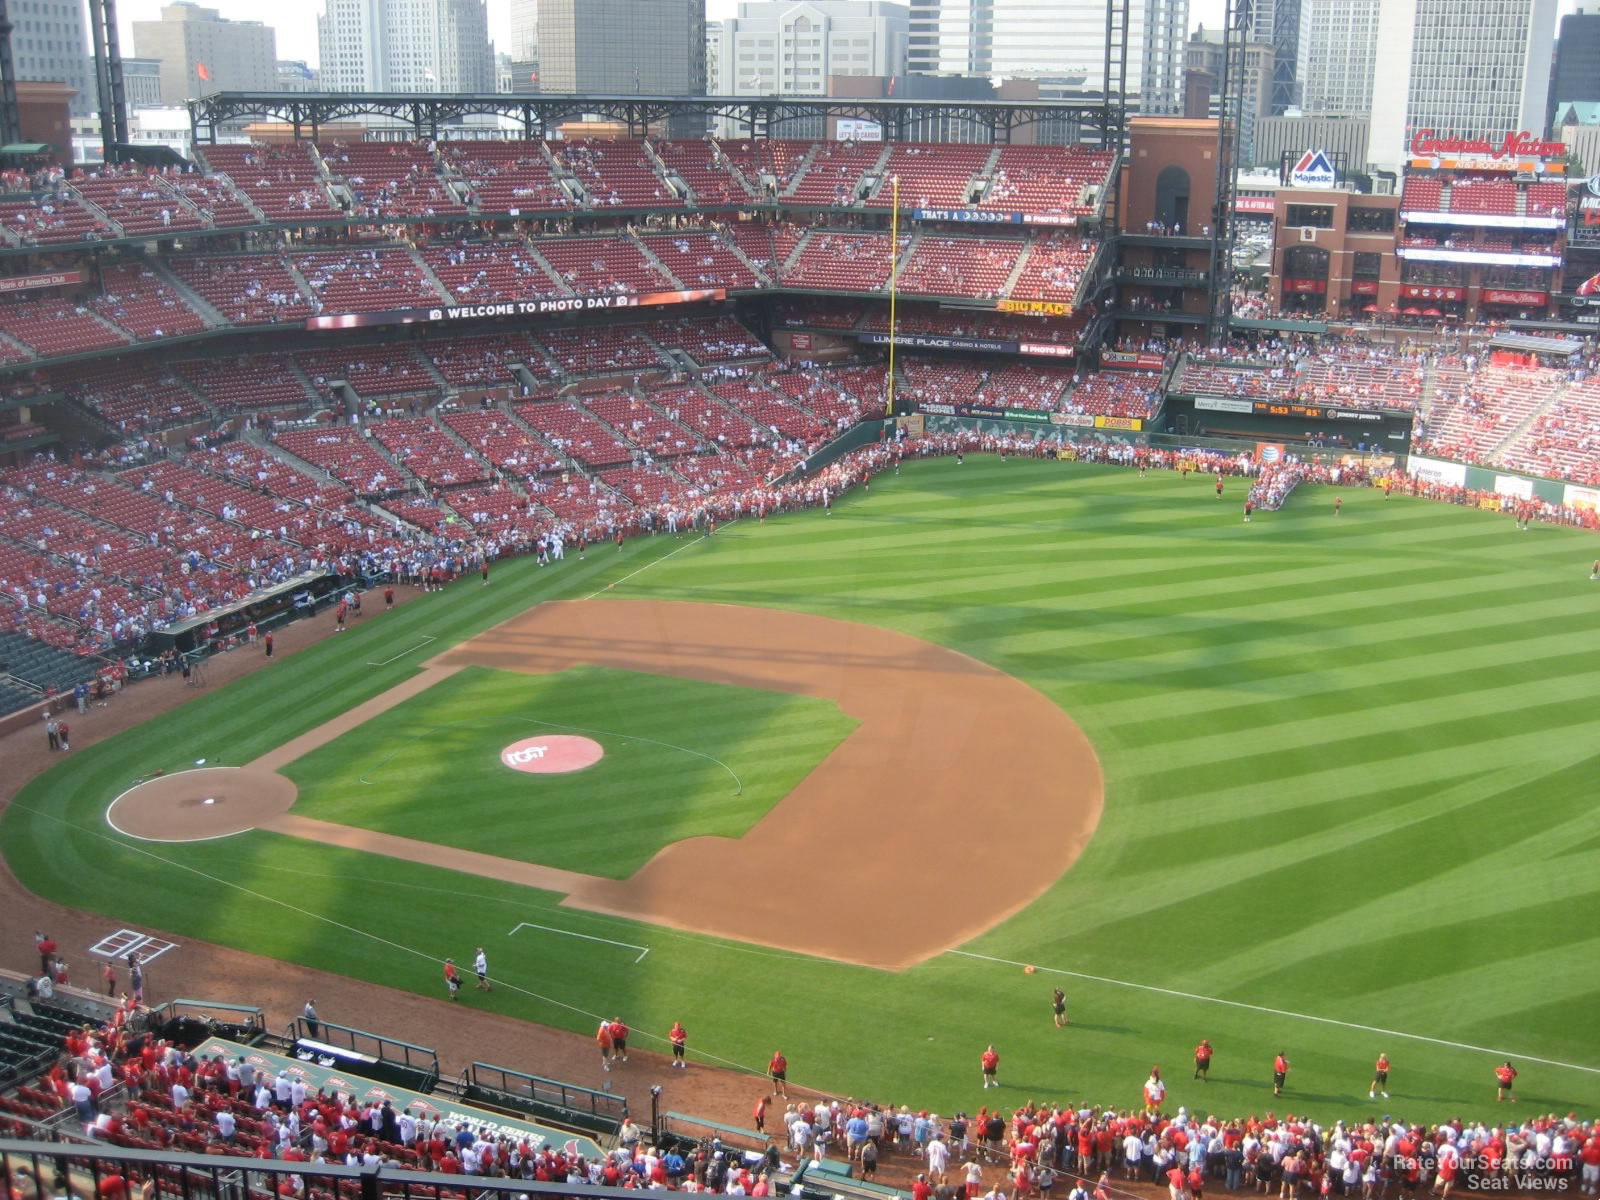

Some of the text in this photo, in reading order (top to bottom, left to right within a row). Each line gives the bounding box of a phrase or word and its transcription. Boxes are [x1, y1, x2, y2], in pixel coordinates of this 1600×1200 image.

[1411, 129, 1566, 160] Cardinals Nation
[1476, 162, 1519, 170] ROOFTOP
[1294, 174, 1332, 183] Majestic
[922, 210, 948, 220] THAT'S
[953, 211, 958, 220] A
[1033, 215, 1075, 224] PHOTO DAY
[448, 298, 611, 318] WELCOME TO PHOTO DAY
[1007, 302, 1063, 314] BIG MAC
[917, 338, 950, 347] PLACE
[1029, 346, 1072, 355] PHOTO DAY
[1270, 406, 1288, 414] 5:53
[448, 1111, 498, 1130] WORLD
[498, 1125, 546, 1142] SERIES
